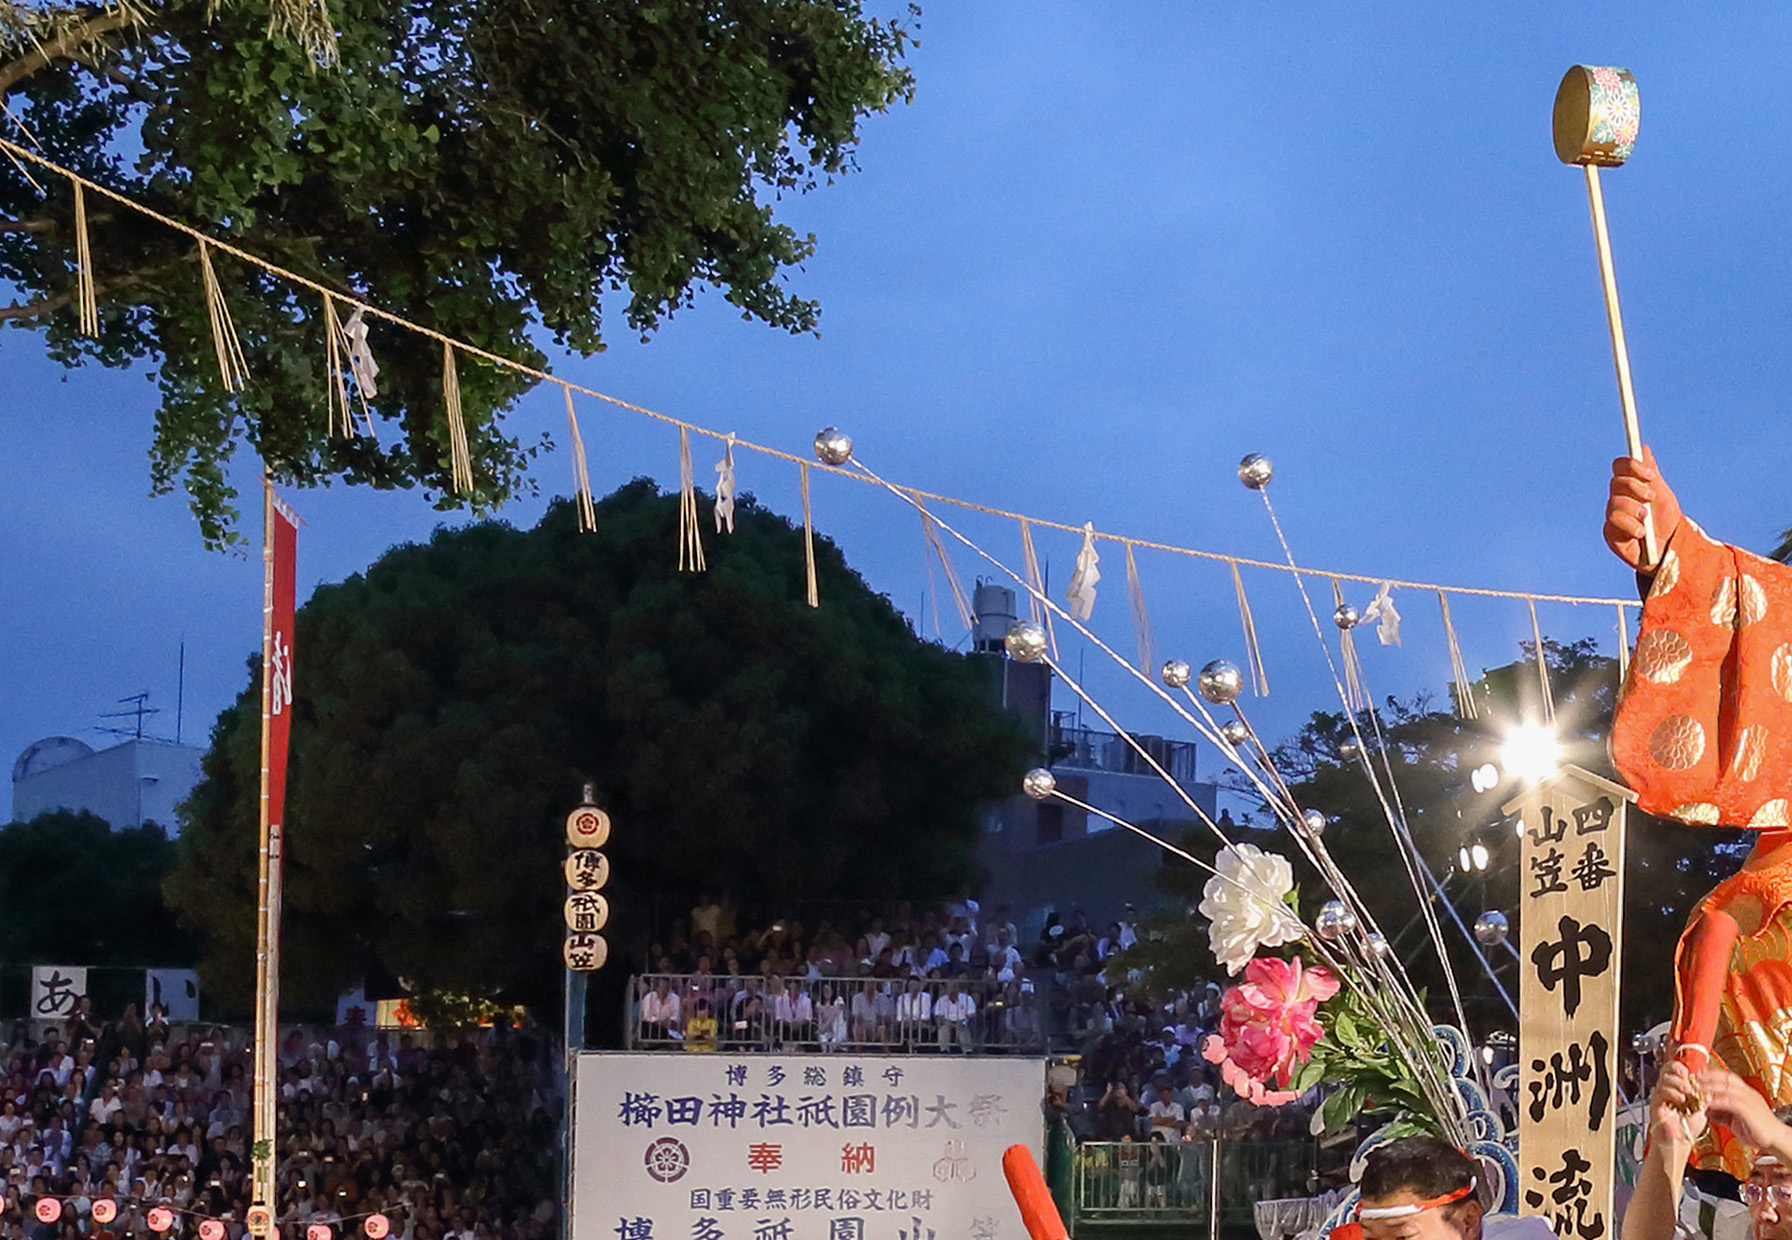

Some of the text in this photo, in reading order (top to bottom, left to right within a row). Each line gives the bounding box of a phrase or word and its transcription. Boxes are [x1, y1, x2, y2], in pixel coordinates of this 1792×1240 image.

[1528, 806, 1568, 899] 山笠
[1571, 796, 1617, 892] 四番
[569, 852, 602, 968] 博多 祇園 山笠
[38, 970, 78, 1016] あ
[725, 1064, 905, 1087] 博多総鎮守
[617, 1092, 1009, 1130] 櫛田神社祇園例大祭
[747, 1142, 876, 1173] 奉納
[690, 1187, 934, 1211] 国重要無形民俗文化財
